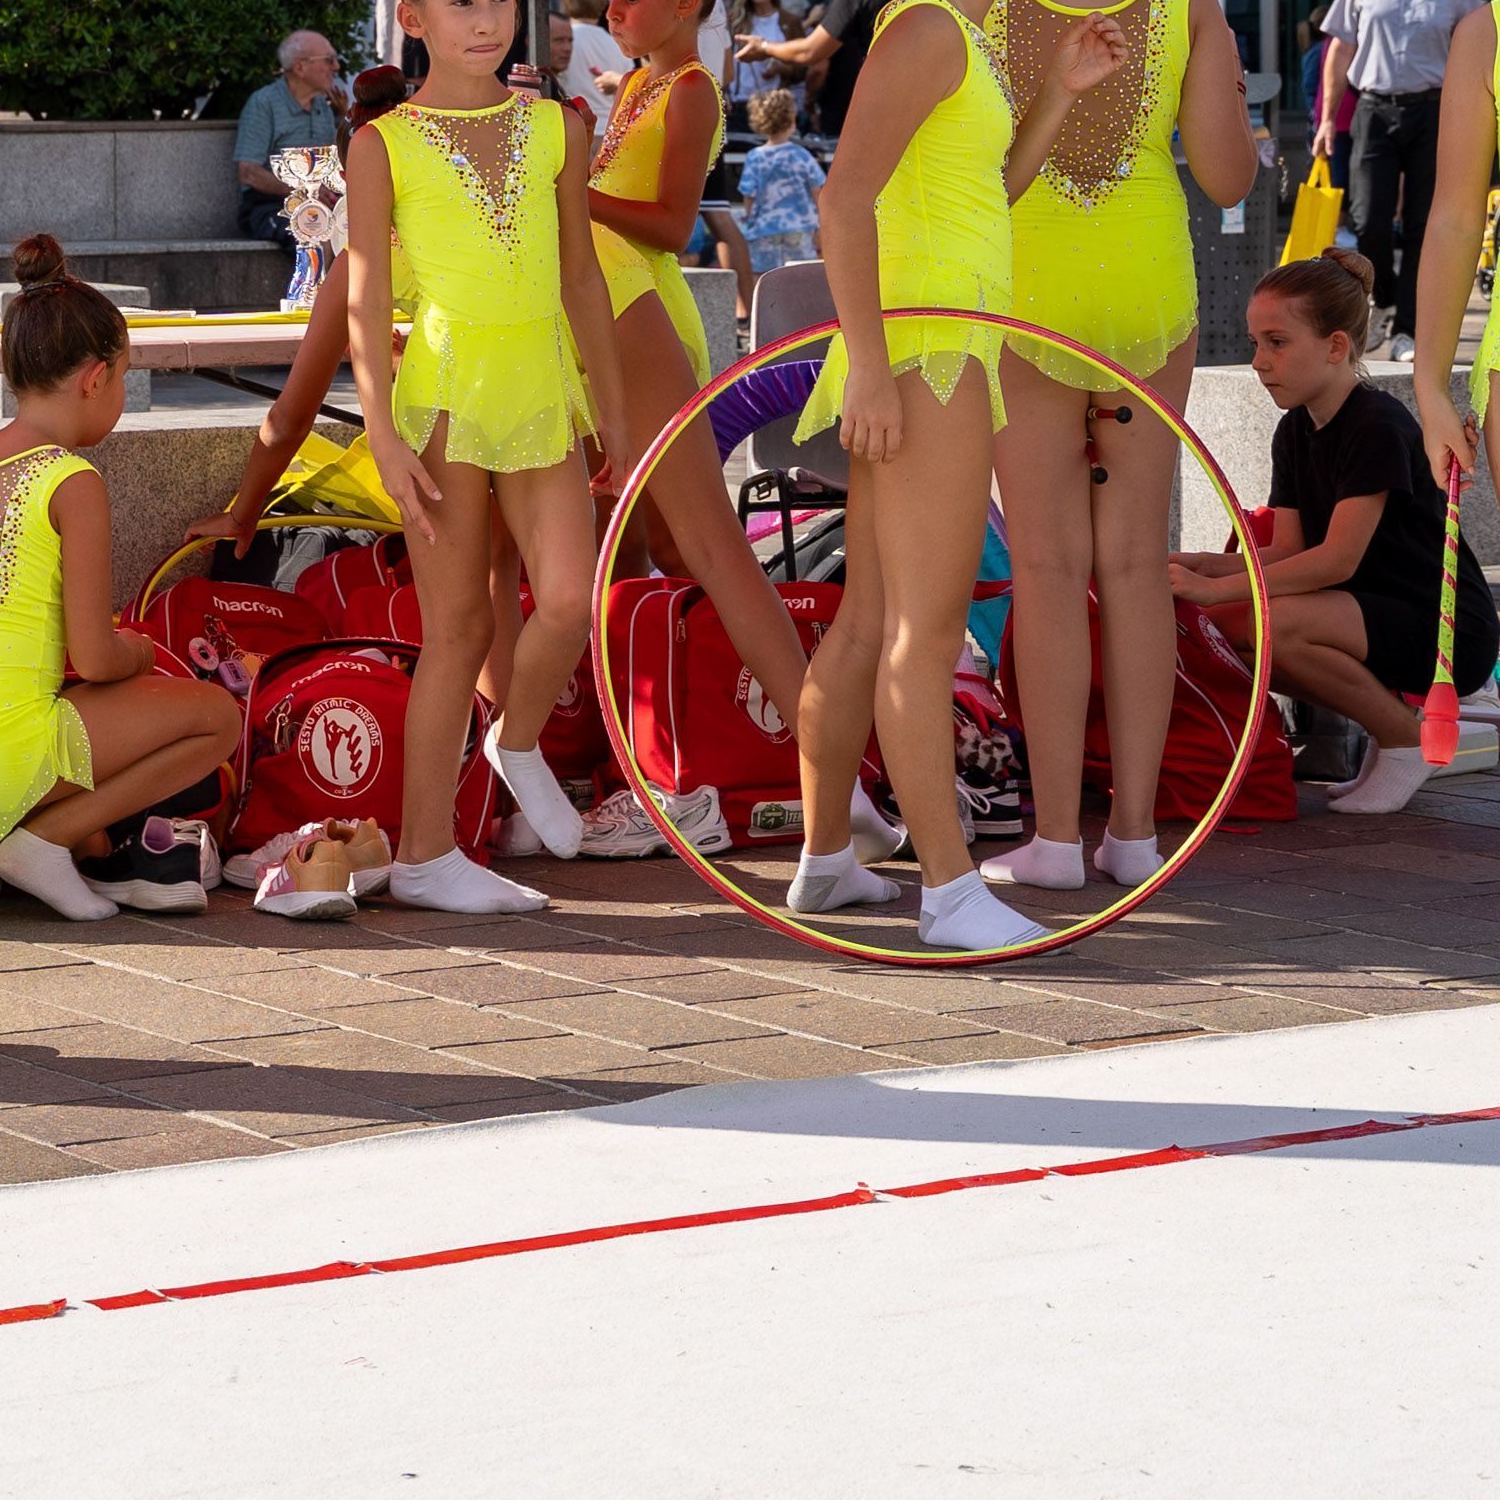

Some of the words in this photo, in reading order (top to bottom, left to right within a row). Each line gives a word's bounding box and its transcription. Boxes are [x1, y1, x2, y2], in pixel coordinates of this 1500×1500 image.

[212, 595, 284, 618] macron
[291, 661, 371, 688] macron
[301, 717, 315, 752] SESTO
[313, 699, 353, 717] RITMIC
[354, 706, 380, 747] DREAMS
